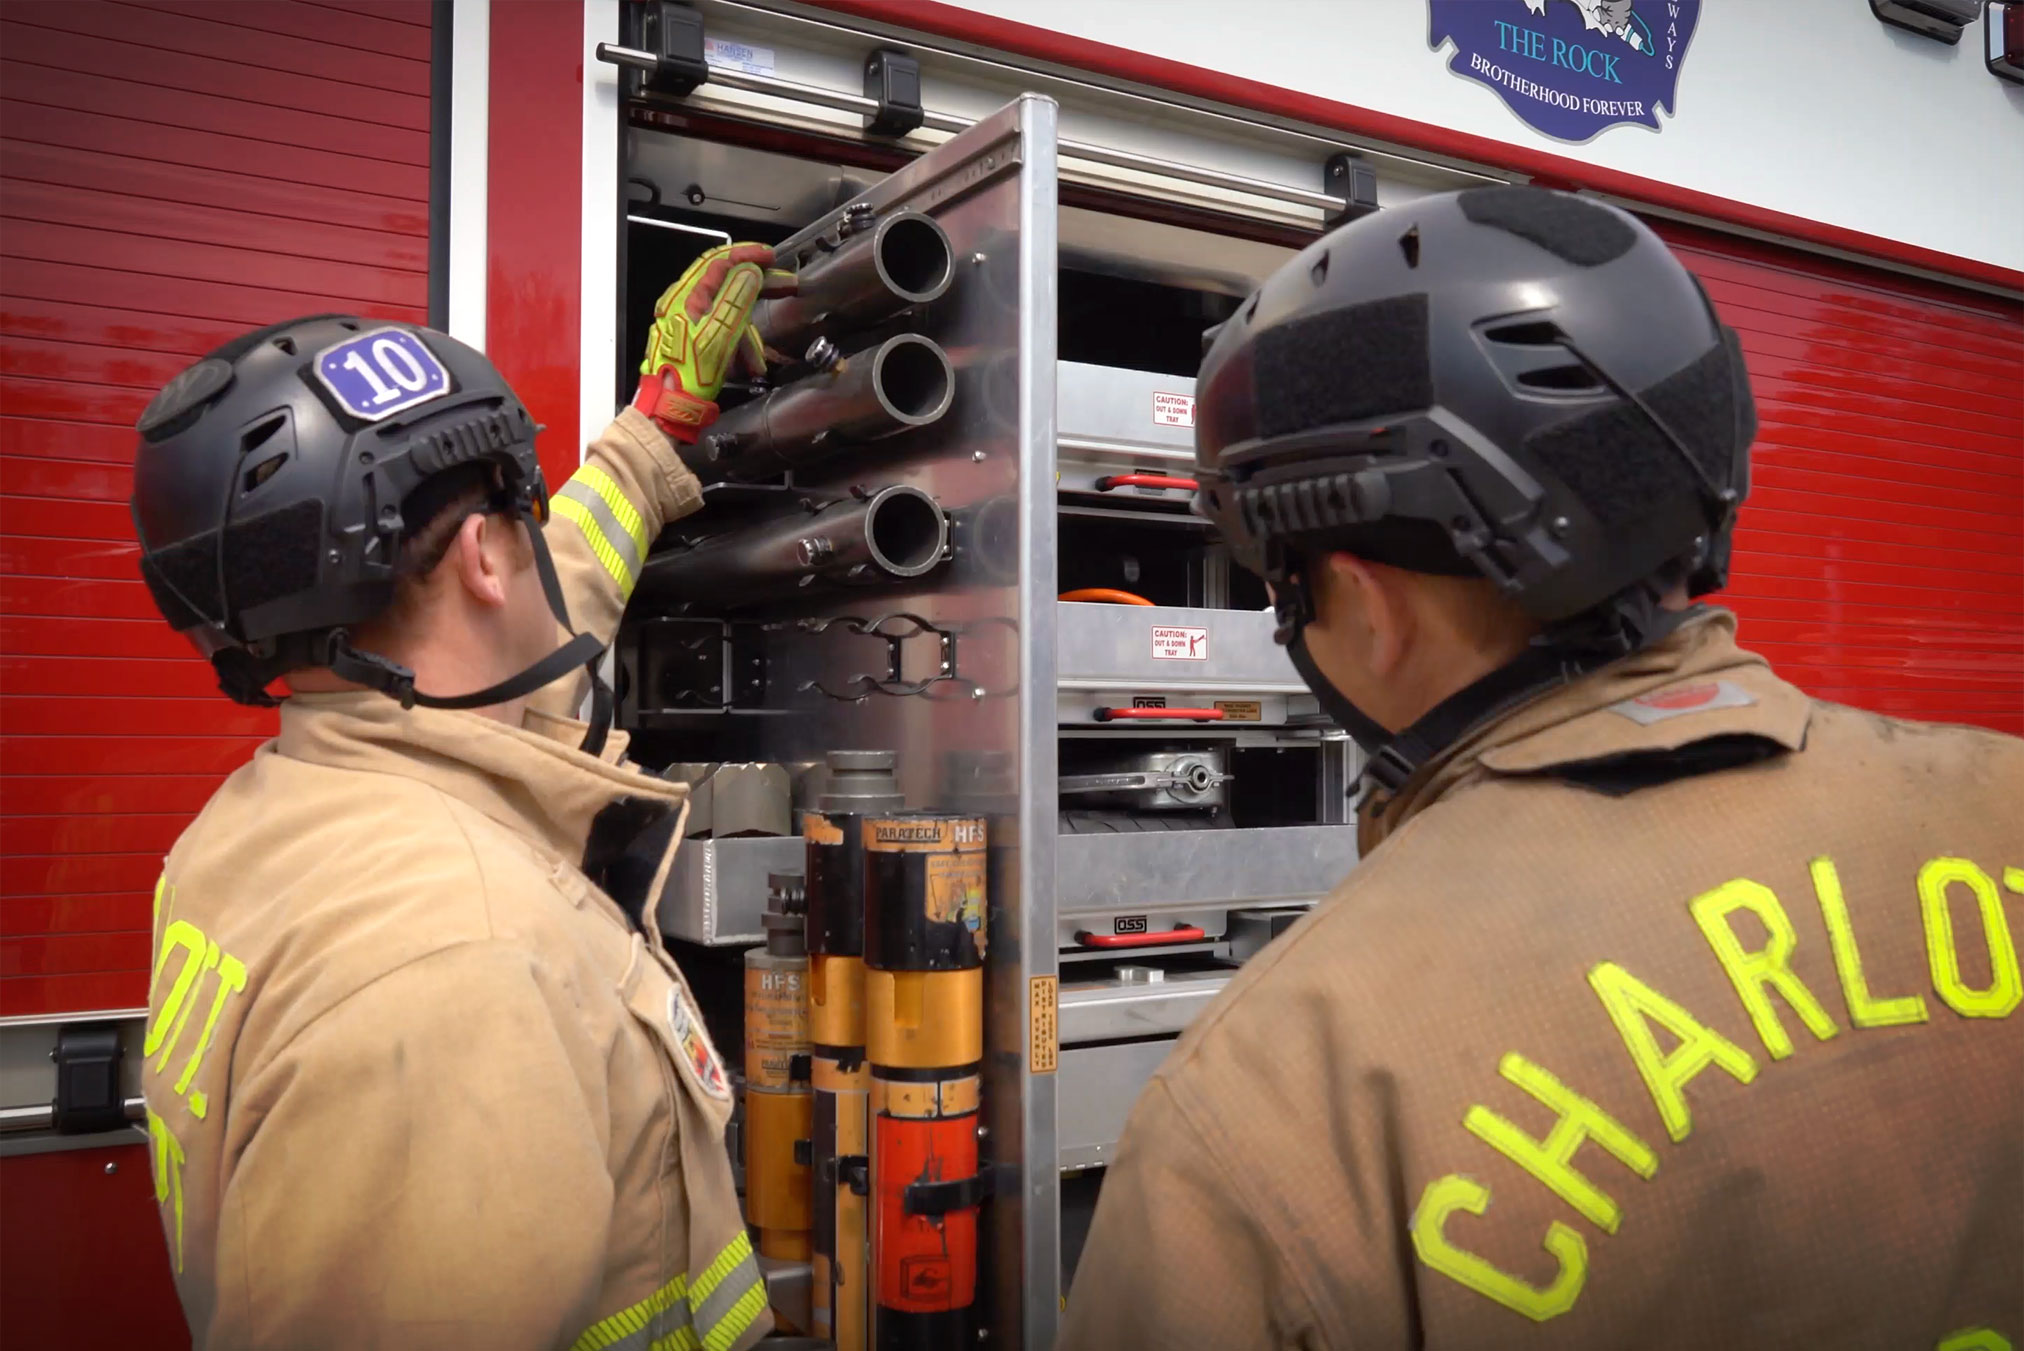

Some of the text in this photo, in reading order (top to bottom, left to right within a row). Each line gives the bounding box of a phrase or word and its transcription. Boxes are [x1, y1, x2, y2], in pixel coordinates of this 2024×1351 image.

[717, 43, 754, 59] HANSEN
[1494, 19, 1623, 85] THE ROCK
[1470, 52, 1645, 117] BROTHERHOOD FOREVER
[342, 338, 428, 405] 10
[1155, 395, 1189, 406] CAUTION:
[1154, 630, 1188, 639] CAUTION:
[876, 824, 984, 843] PARATECH HFS
[1117, 919, 1144, 931] OSS
[761, 973, 800, 991] HFS
[1410, 855, 2024, 1322] CHARLO
